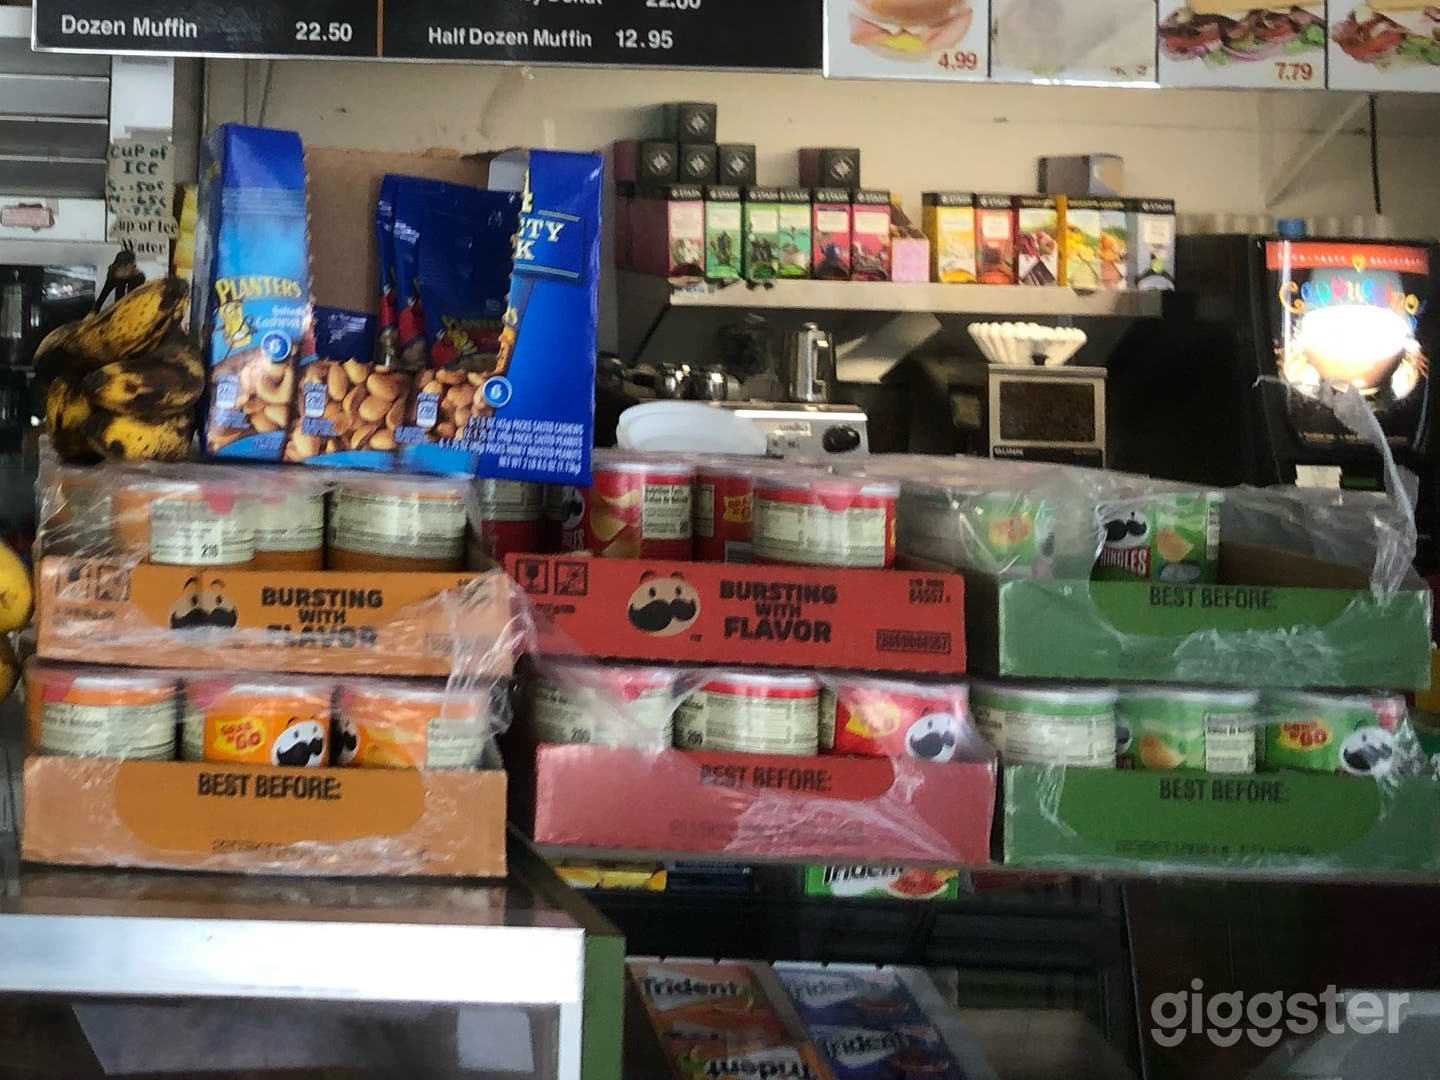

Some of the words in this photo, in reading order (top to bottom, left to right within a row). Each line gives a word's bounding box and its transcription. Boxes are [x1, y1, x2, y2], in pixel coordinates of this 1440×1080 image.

[61, 14, 126, 36] Dozen
[133, 17, 198, 38] Muffin
[295, 22, 352, 42] 22.50
[428, 27, 467, 46] Half
[469, 28, 528, 48] Dozen
[533, 29, 593, 49] Muffin
[615, 29, 674, 50] 12.95
[938, 51, 978, 72] 4.99
[1274, 61, 1313, 81] 7.79
[157, 220, 178, 234] Ice
[215, 276, 302, 304] PLANTERS
[262, 585, 384, 609] BURSTING
[719, 579, 838, 605] BURSTING
[1150, 585, 1197, 607] BEST
[298, 608, 346, 623] WITH
[755, 602, 803, 619] WITH
[266, 624, 378, 649] FLAVOR
[723, 616, 832, 643] FLAVOR
[198, 772, 248, 797] BEST
[255, 774, 342, 800] BEFORE:
[699, 764, 747, 788] BEST
[753, 767, 832, 792] BEFORE:
[1160, 779, 1207, 801] BEST
[642, 977, 739, 997] Trident
